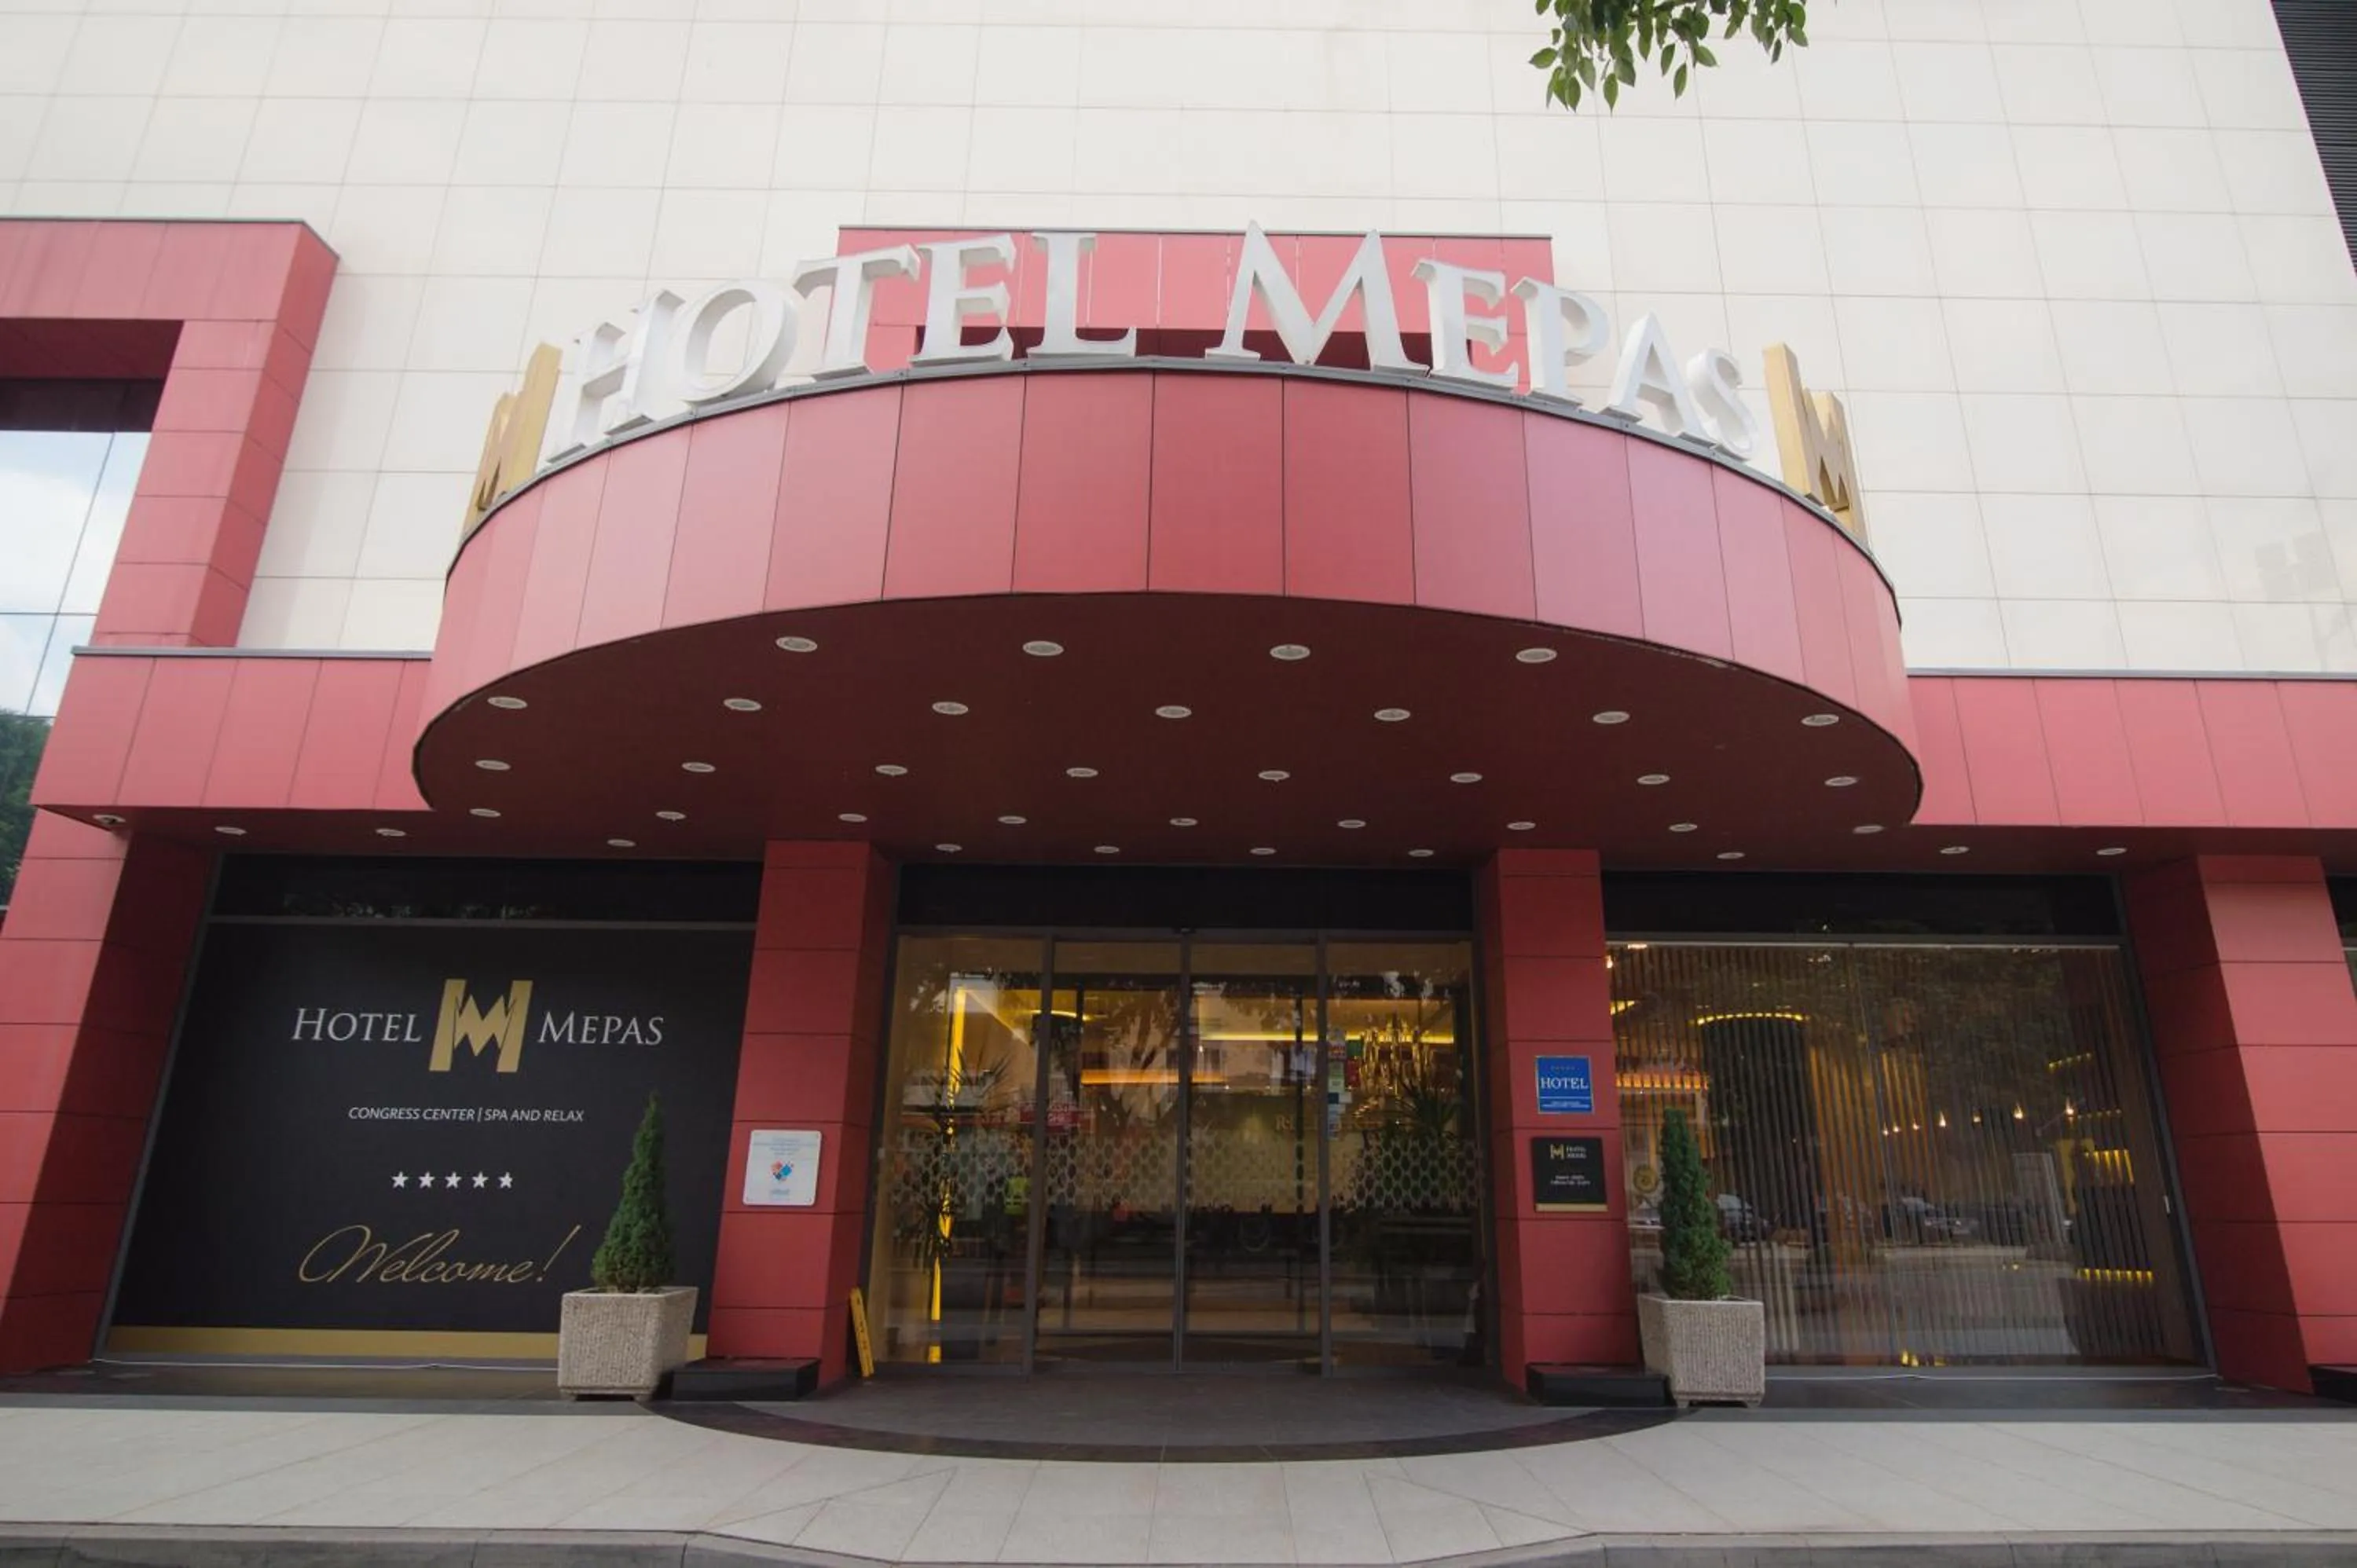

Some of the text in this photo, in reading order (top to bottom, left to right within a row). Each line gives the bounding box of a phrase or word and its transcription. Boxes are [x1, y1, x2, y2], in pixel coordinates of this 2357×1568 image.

[535, 231, 1138, 471] HOTEL
[1204, 220, 1759, 463] MEPAS
[291, 1008, 422, 1042] HOTEL
[537, 1009, 665, 1046] MEPAS
[1540, 1077, 1589, 1090] HOTEL
[348, 1106, 420, 1120] CONGRESS
[422, 1108, 476, 1122] CENTER
[484, 1108, 508, 1122] SPA
[510, 1108, 541, 1122] AND
[543, 1109, 585, 1123] RELAX
[299, 1224, 581, 1284] Welcome!
